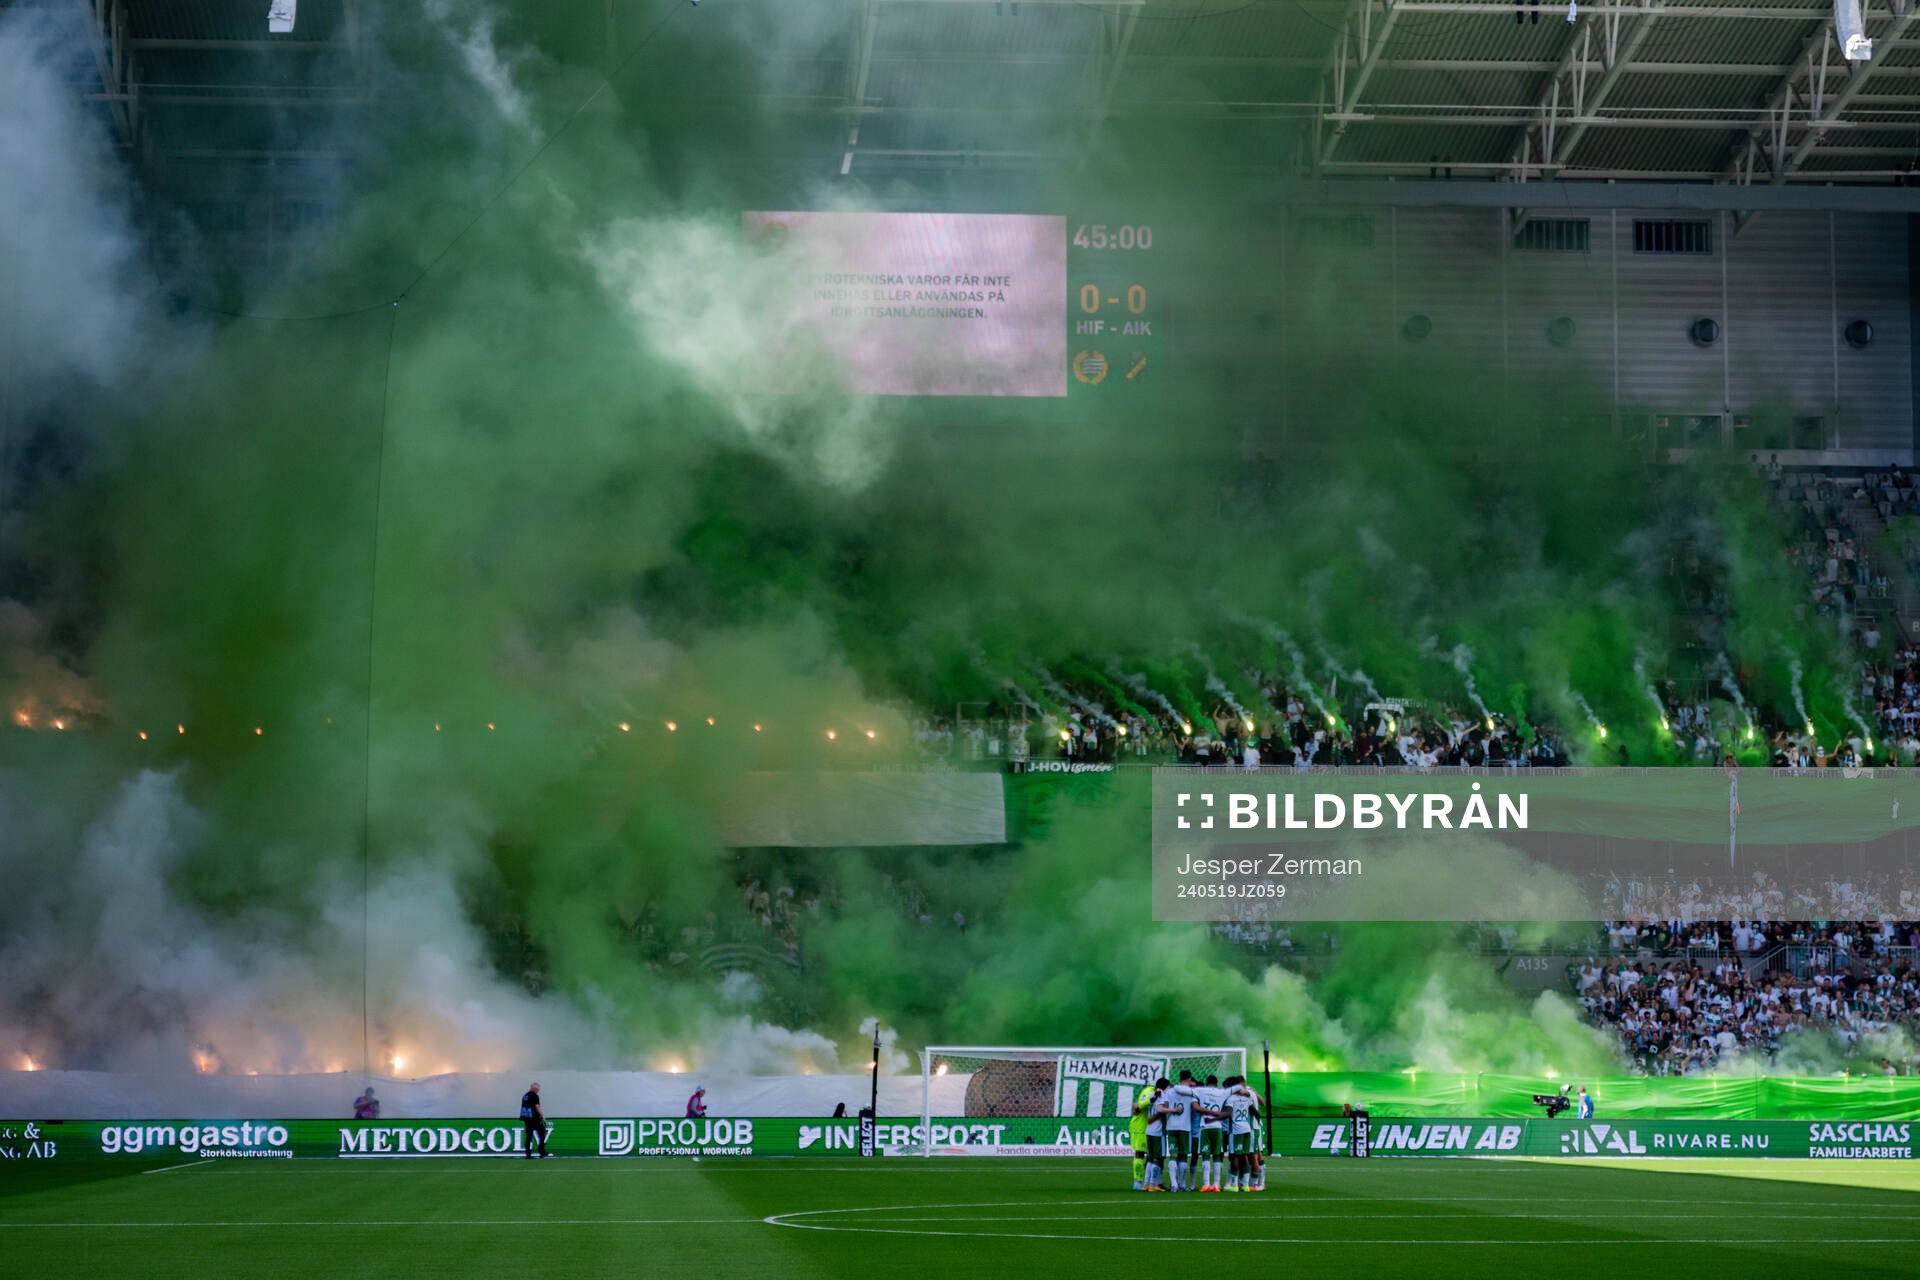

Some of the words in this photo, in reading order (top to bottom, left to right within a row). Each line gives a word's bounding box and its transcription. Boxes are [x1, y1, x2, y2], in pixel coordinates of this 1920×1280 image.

[1073, 224, 1153, 249] 45:00
[907, 275, 951, 286] VAROR
[955, 273, 979, 287] FÅR
[983, 275, 1011, 287] INTE
[873, 289, 911, 301] ELLER
[916, 290, 984, 302] ANVÄNDAS
[988, 289, 1005, 302] PÅ
[1080, 283, 1100, 314] 0
[1127, 284, 1147, 314] 0
[1076, 320, 1105, 335] HIF
[1122, 321, 1152, 336] AIK
[1516, 958, 1549, 971] A135
[1069, 1060, 1160, 1081] HAMMARBY
[1235, 1109, 1248, 1122] 28
[24, 1122, 40, 1139] &
[638, 1119, 753, 1145] PROJOB
[861, 1117, 873, 1157] SELECT
[1356, 1117, 1367, 1157] SELECT
[1475, 1125, 1522, 1149] AB
[1809, 1123, 1910, 1142] SASCHAS
[27, 1141, 56, 1158] AB
[1654, 1134, 1769, 1148] RIVARE.NU
[702, 1147, 753, 1156] WORKWEAR
[996, 1147, 1030, 1155] Handla
[1033, 1147, 1061, 1155] online
[1809, 1147, 1912, 1158] FAMILJEARBETE
